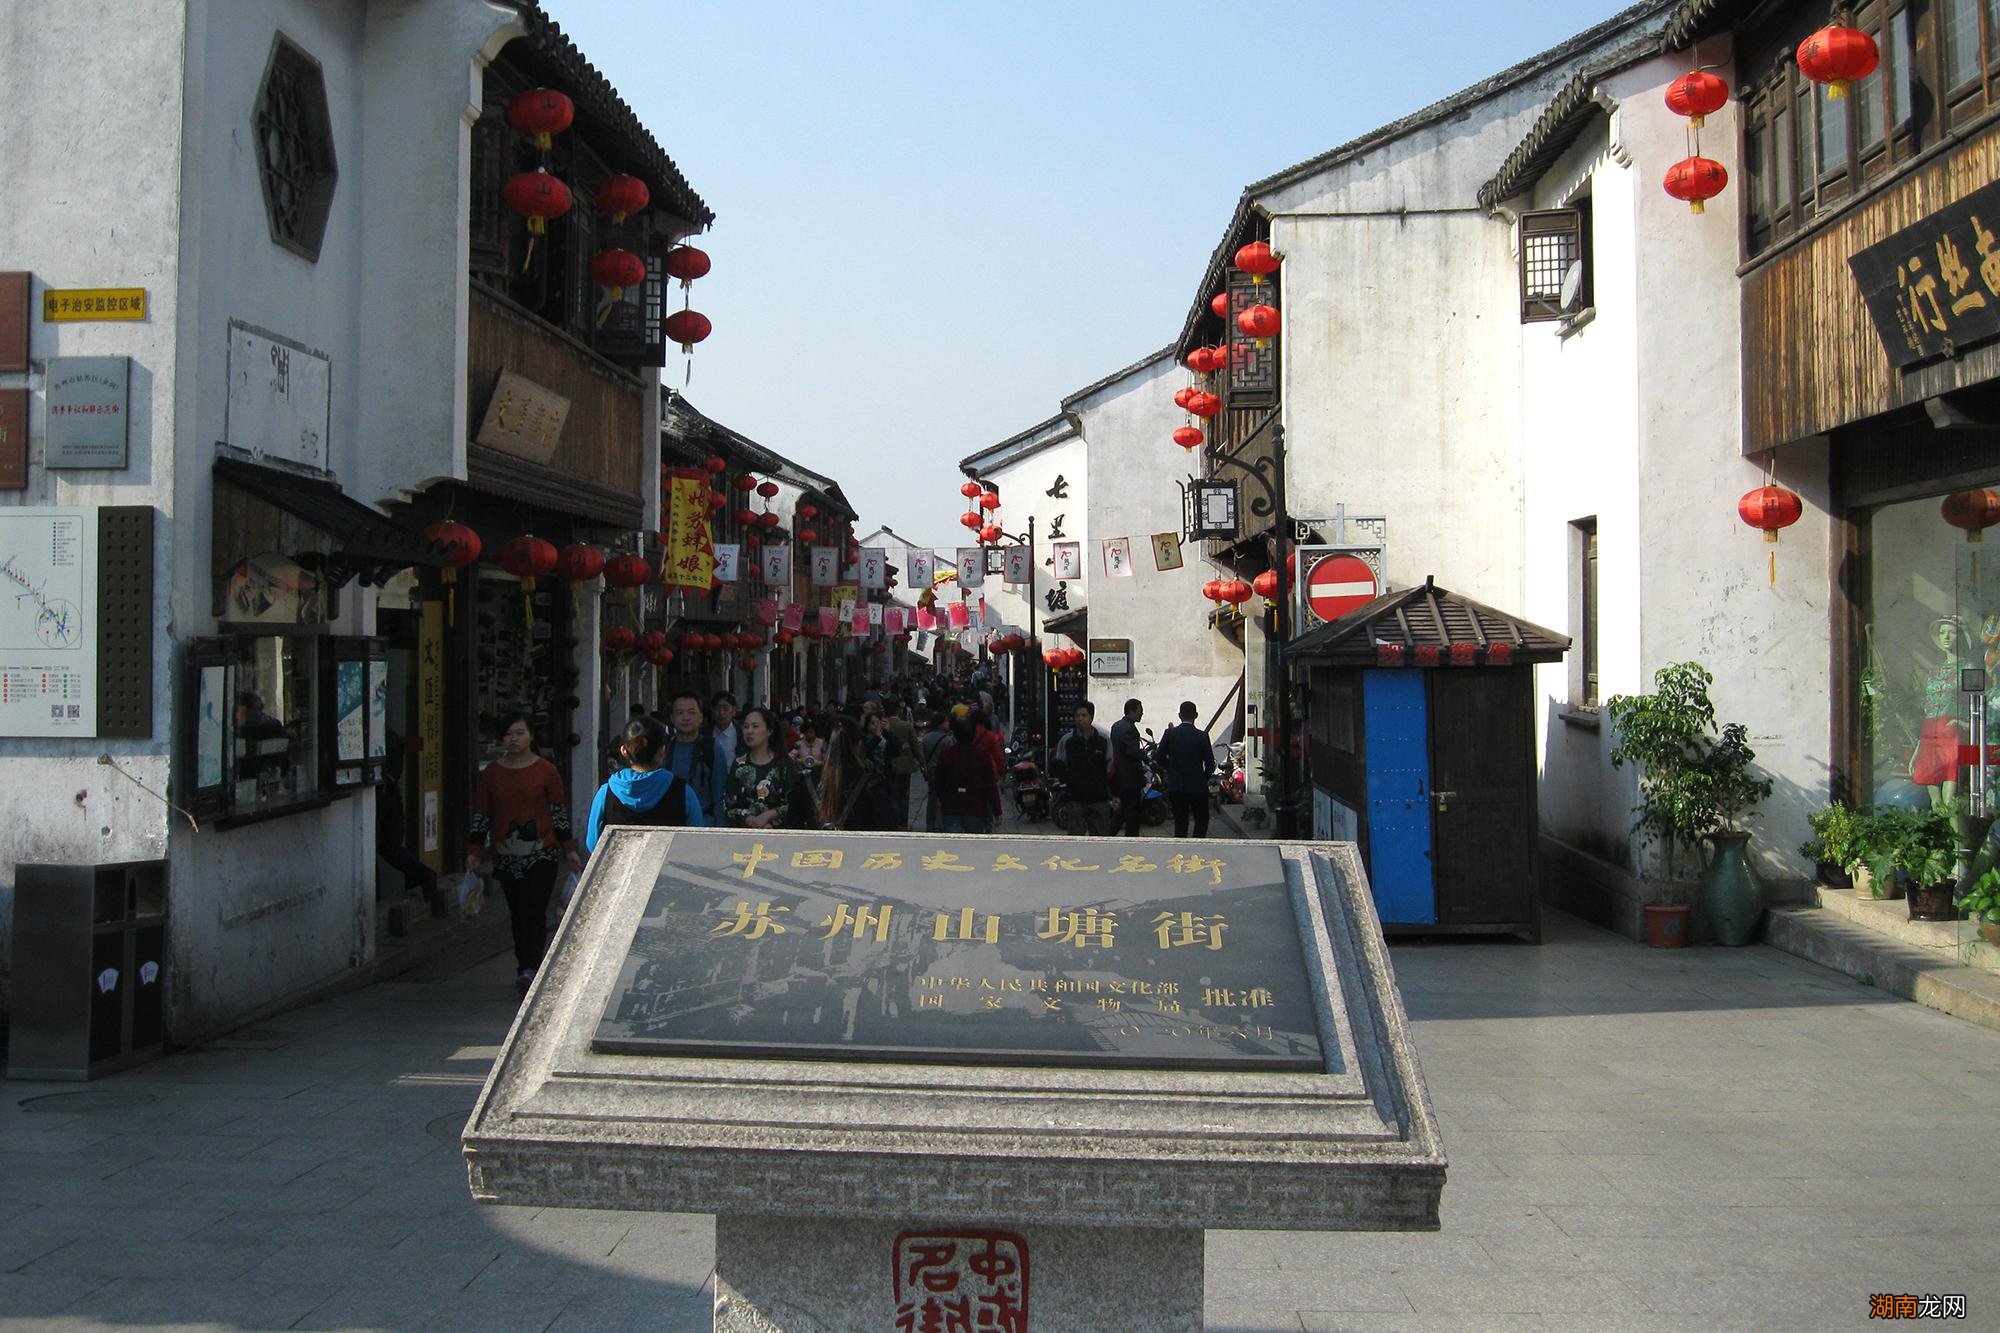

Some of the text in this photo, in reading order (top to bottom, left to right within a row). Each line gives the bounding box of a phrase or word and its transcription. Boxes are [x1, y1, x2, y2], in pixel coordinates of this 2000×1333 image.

[49, 296, 141, 312] 电子治安监控区域
[1045, 474, 1071, 612] 七里塘
[733, 843, 1228, 885] 中国历史文化名街
[709, 901, 1230, 950] 苏州山塘街
[919, 975, 1179, 995] 中华人民共和国文化部
[918, 994, 1181, 1014] 国家文物局
[1201, 986, 1276, 1009] 批准
